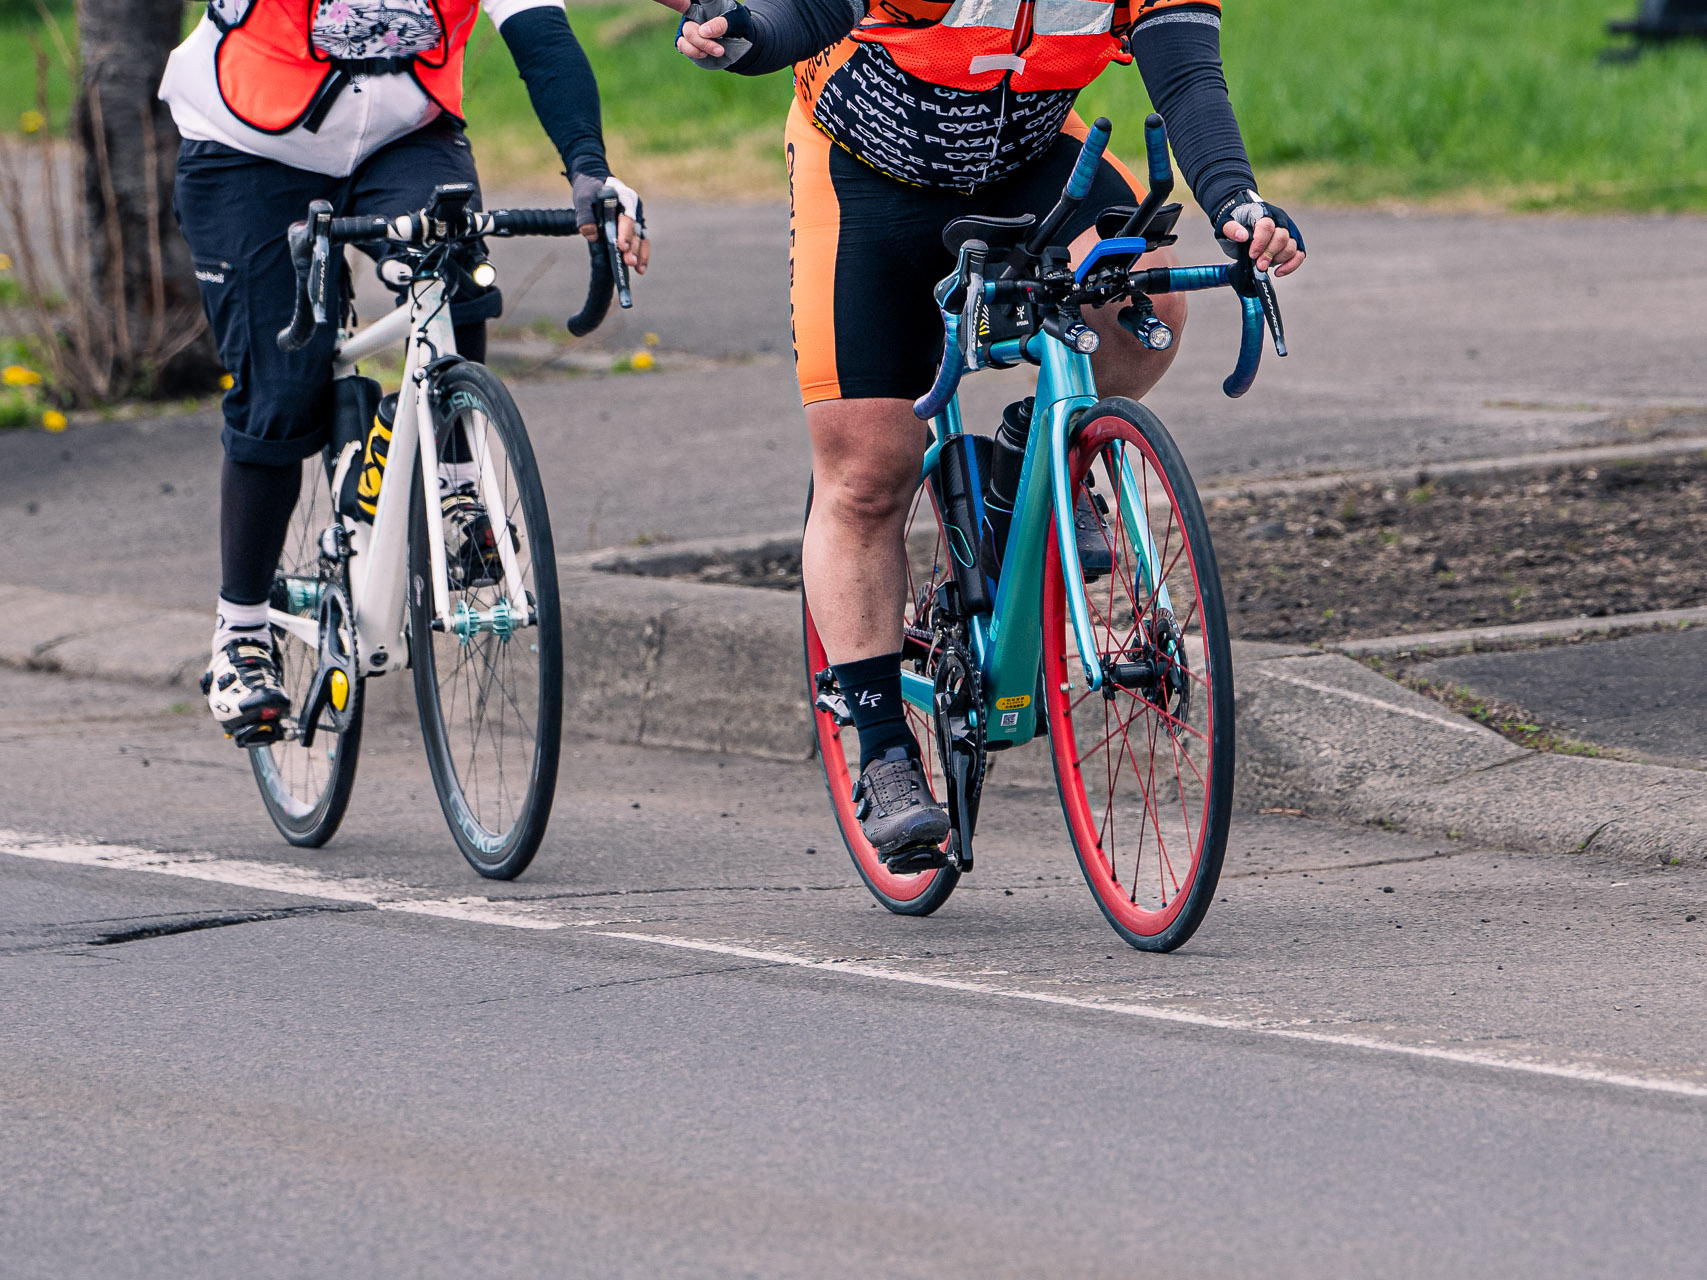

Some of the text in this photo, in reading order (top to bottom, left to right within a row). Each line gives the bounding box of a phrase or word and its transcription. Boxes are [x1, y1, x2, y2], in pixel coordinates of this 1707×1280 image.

[851, 68, 909, 120] PLAZA
[862, 62, 917, 108] CYCLE
[920, 100, 992, 117] PLAZA
[846, 98, 913, 150] PLAZA
[854, 93, 920, 140] CYCLE
[924, 133, 1000, 149] PLAZA
[855, 123, 927, 167] CYCLE
[849, 127, 920, 176] PLAZA
